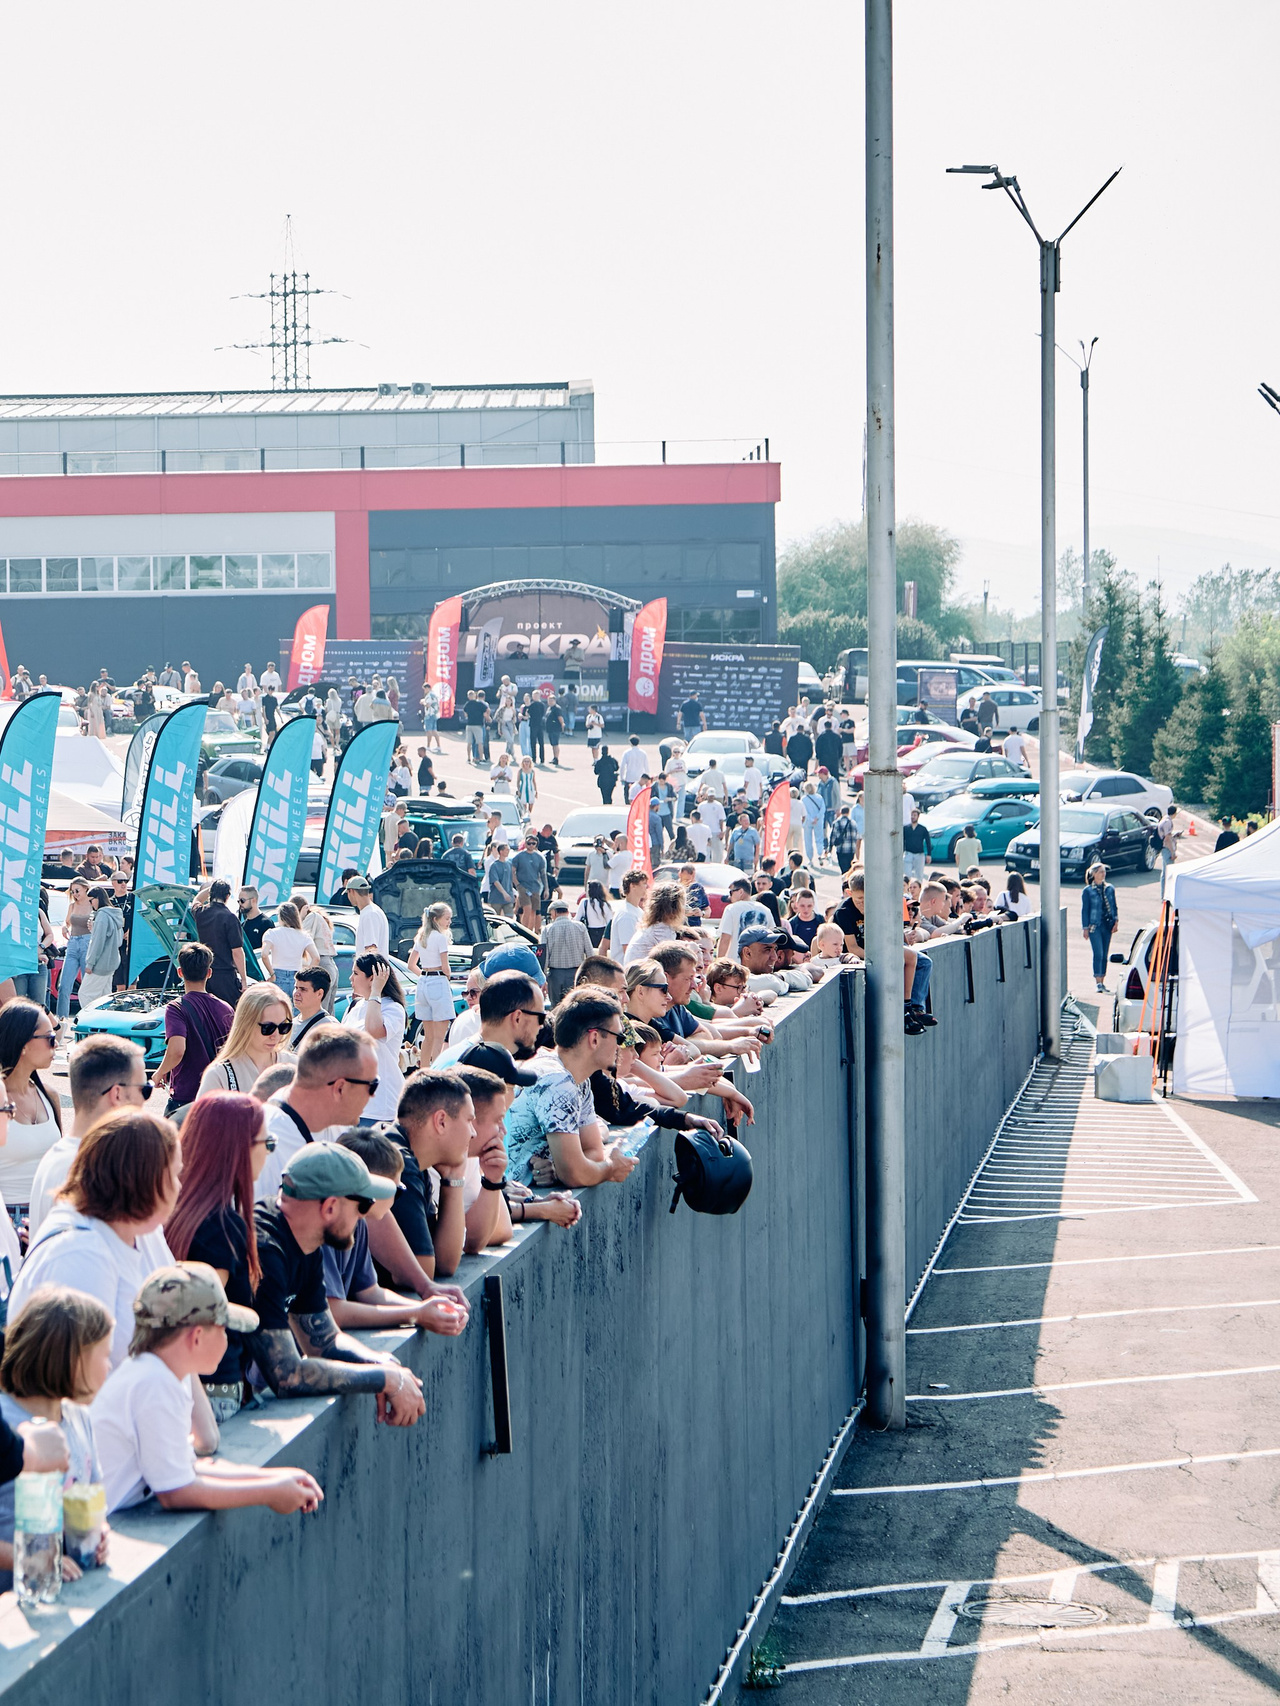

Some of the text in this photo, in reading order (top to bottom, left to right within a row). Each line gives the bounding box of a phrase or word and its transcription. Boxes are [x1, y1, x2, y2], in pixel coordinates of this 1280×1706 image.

[517, 621, 562, 631] проект
[710, 653, 745, 662] ИСКРА
[141, 761, 187, 909] KILL
[178, 767, 194, 842] WHEELS
[291, 775, 304, 842] WHEELS
[366, 774, 383, 837] WHEELS
[24, 768, 47, 950] FORGED WHEELS
